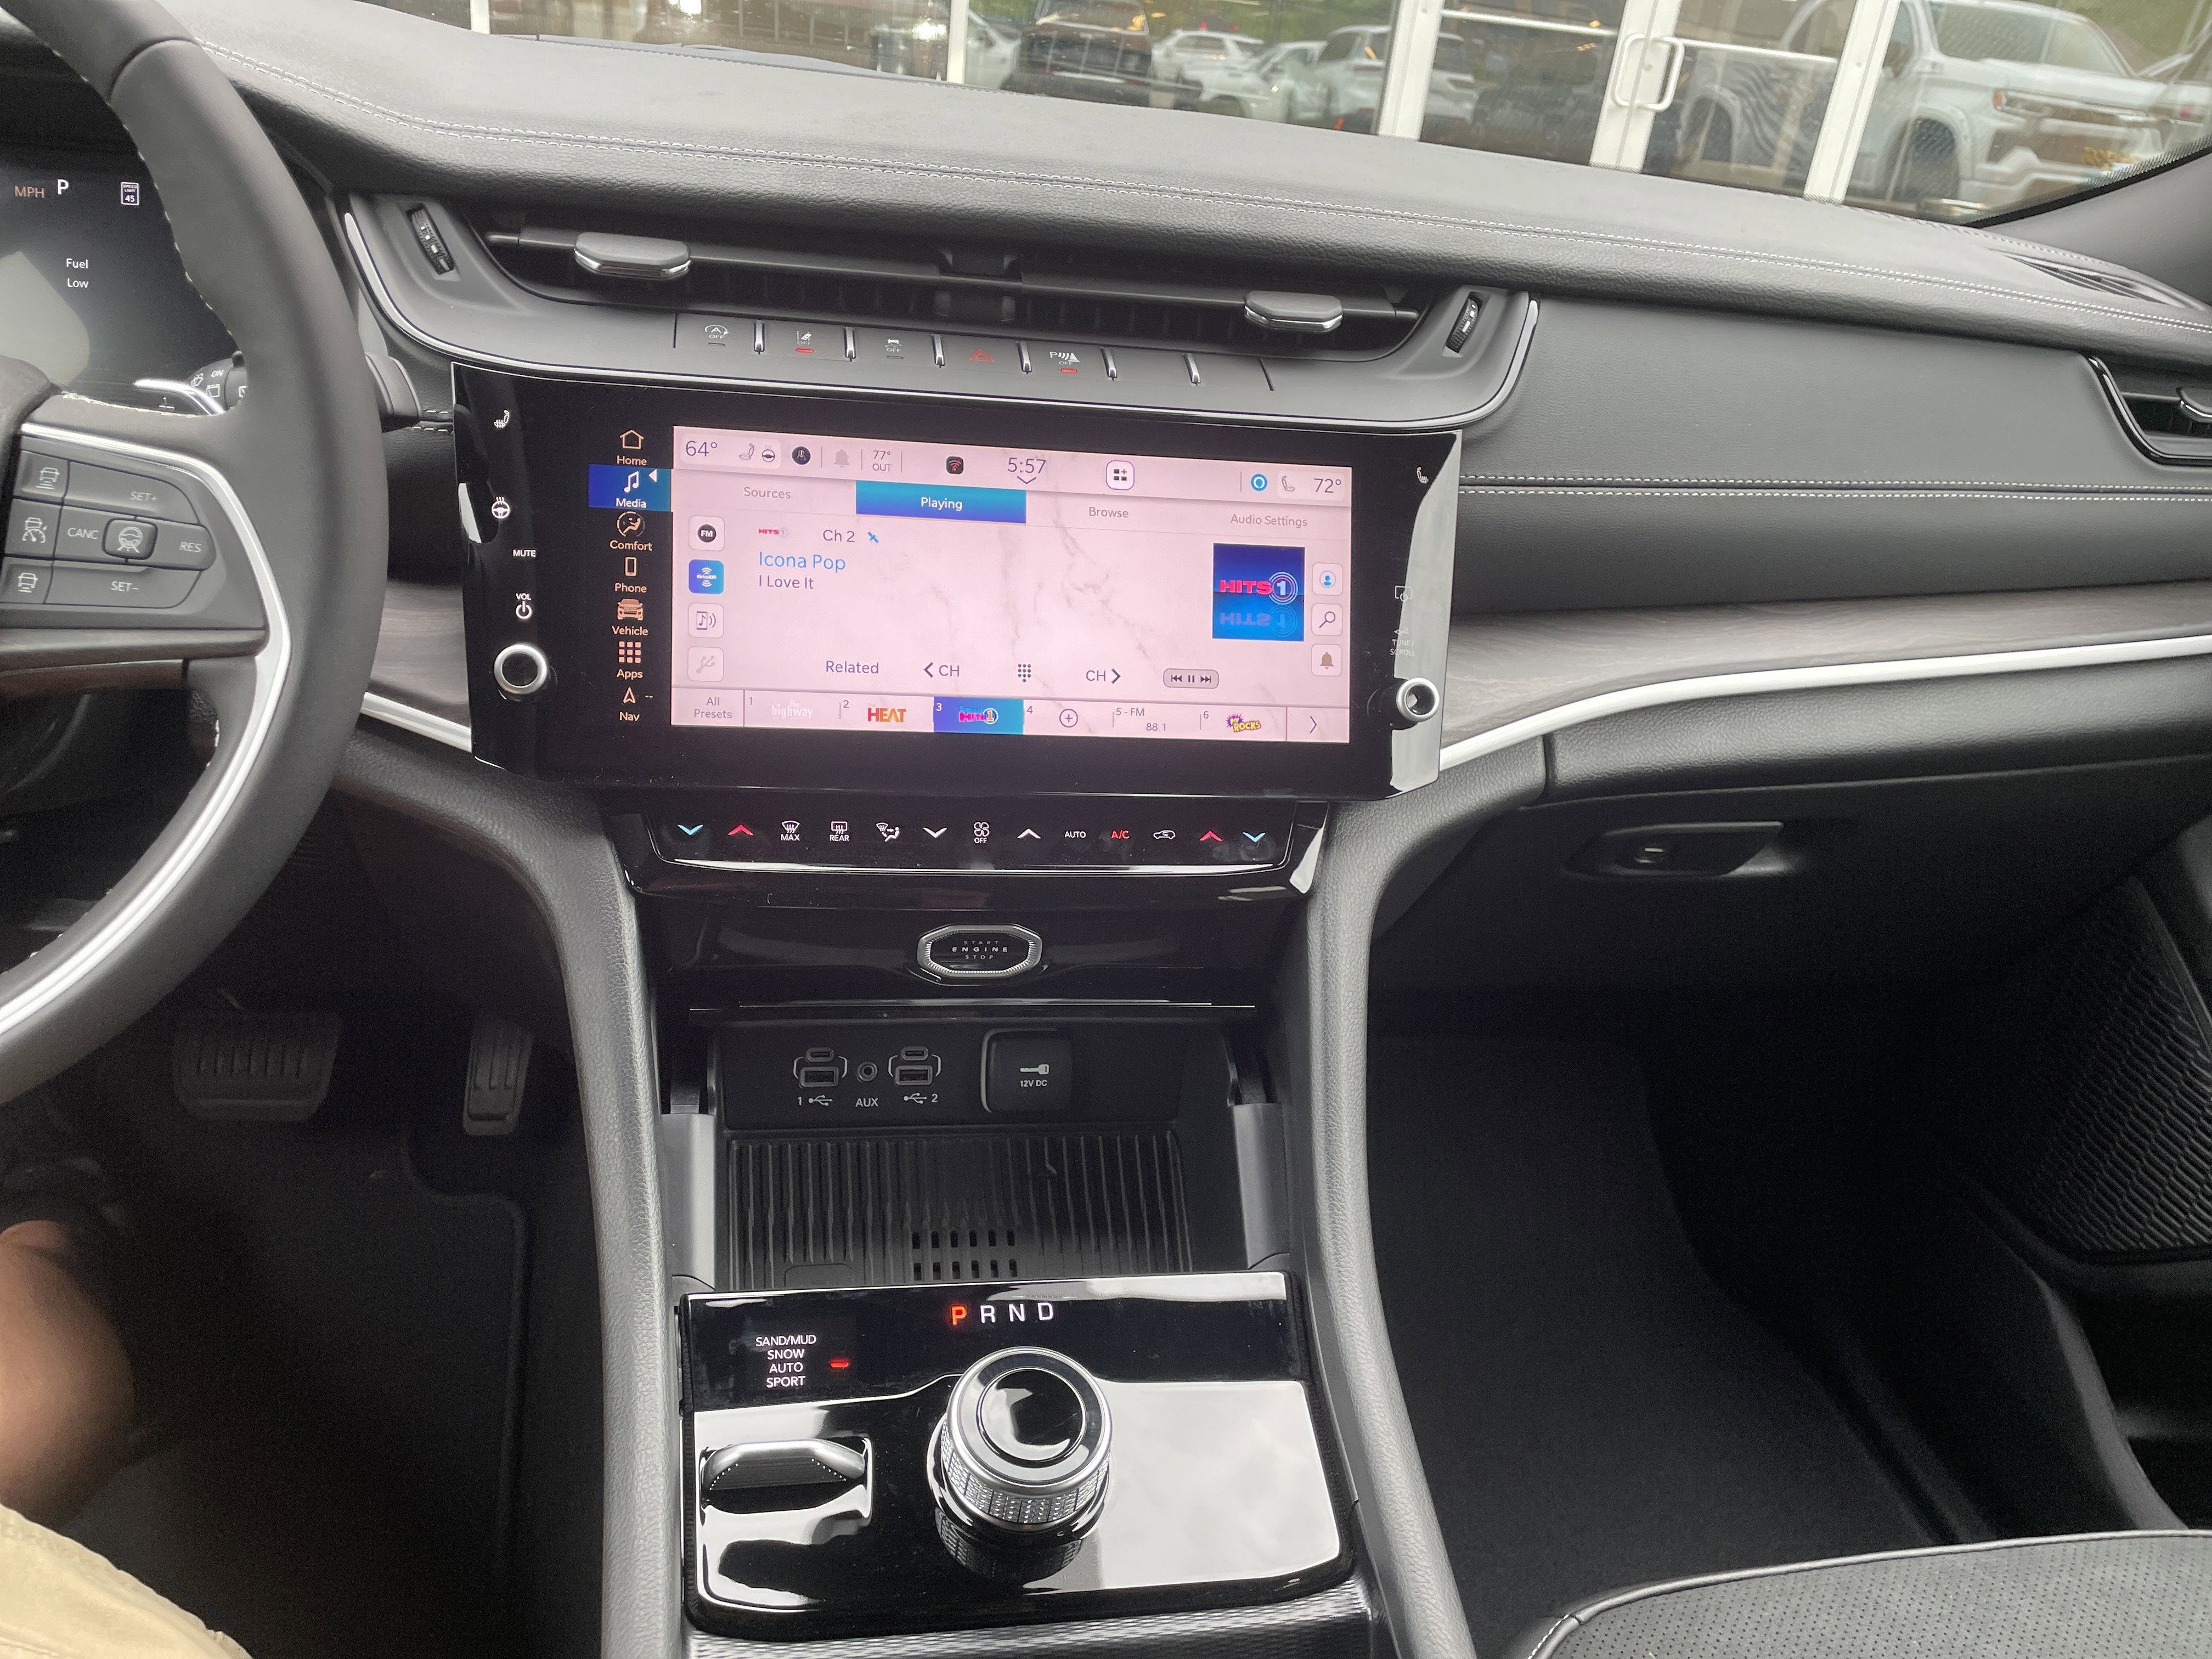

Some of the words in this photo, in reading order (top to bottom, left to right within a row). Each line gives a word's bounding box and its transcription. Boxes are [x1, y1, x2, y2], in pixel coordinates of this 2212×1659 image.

[14, 186, 44, 198] MPH
[57, 179, 69, 195] P
[66, 258, 89, 269] Fuel
[67, 278, 89, 288] Low
[211, 369, 224, 377] ON
[617, 455, 647, 466] Home
[1007, 457, 1046, 474] 5:57
[872, 463, 892, 472] OUT
[129, 491, 157, 501] SET+
[743, 487, 791, 499] Sources
[616, 498, 647, 509] Media
[921, 496, 963, 512] Playing
[1088, 506, 1129, 519] Browse
[1230, 514, 1262, 526] Audio
[1264, 515, 1308, 528] Settings
[67, 527, 99, 540] CANC
[701, 529, 713, 538] FM
[823, 529, 843, 543] Ch
[847, 531, 855, 543] 2
[179, 541, 201, 552] RES
[609, 540, 652, 551] Comfort
[512, 549, 537, 557] MUTE
[759, 551, 806, 568] Icona
[813, 554, 846, 573] Pop
[614, 583, 647, 593] Phone
[759, 575, 762, 586] I
[766, 575, 800, 589] Love
[804, 577, 814, 590] It
[1220, 579, 1272, 595] HITS
[1277, 580, 1286, 596] 1
[612, 625, 648, 636] Vehicle
[1390, 648, 1415, 656] SCROLL
[825, 660, 879, 675] Related
[939, 665, 960, 678] CH
[616, 669, 643, 679] Apps
[1086, 670, 1107, 683] CH
[706, 697, 720, 706] All
[749, 697, 754, 706] 1
[843, 700, 849, 708] 2
[936, 702, 943, 712] 3
[693, 708, 732, 720] Presets
[868, 707, 906, 723] HEAT
[1026, 706, 1033, 714] 4
[1130, 708, 1145, 717] FM
[1203, 710, 1209, 719] 6
[619, 712, 640, 721] Nav
[1146, 722, 1166, 732] 88.1
[1233, 721, 1261, 732] ROCKS
[830, 834, 850, 842] REAR
[1111, 830, 1130, 839] A/C
[797, 1096, 803, 1105] 1
[855, 1098, 878, 1107] AUX
[932, 1093, 938, 1103] 2
[951, 1305, 967, 1325] P
[980, 1305, 996, 1324] R
[1008, 1303, 1025, 1322] N
[1037, 1302, 1054, 1321] D
[755, 1334, 817, 1347] SAND/MUD
[767, 1348, 805, 1361] SNOW
[769, 1362, 803, 1373] AUTO
[766, 1376, 805, 1388] SPORT
